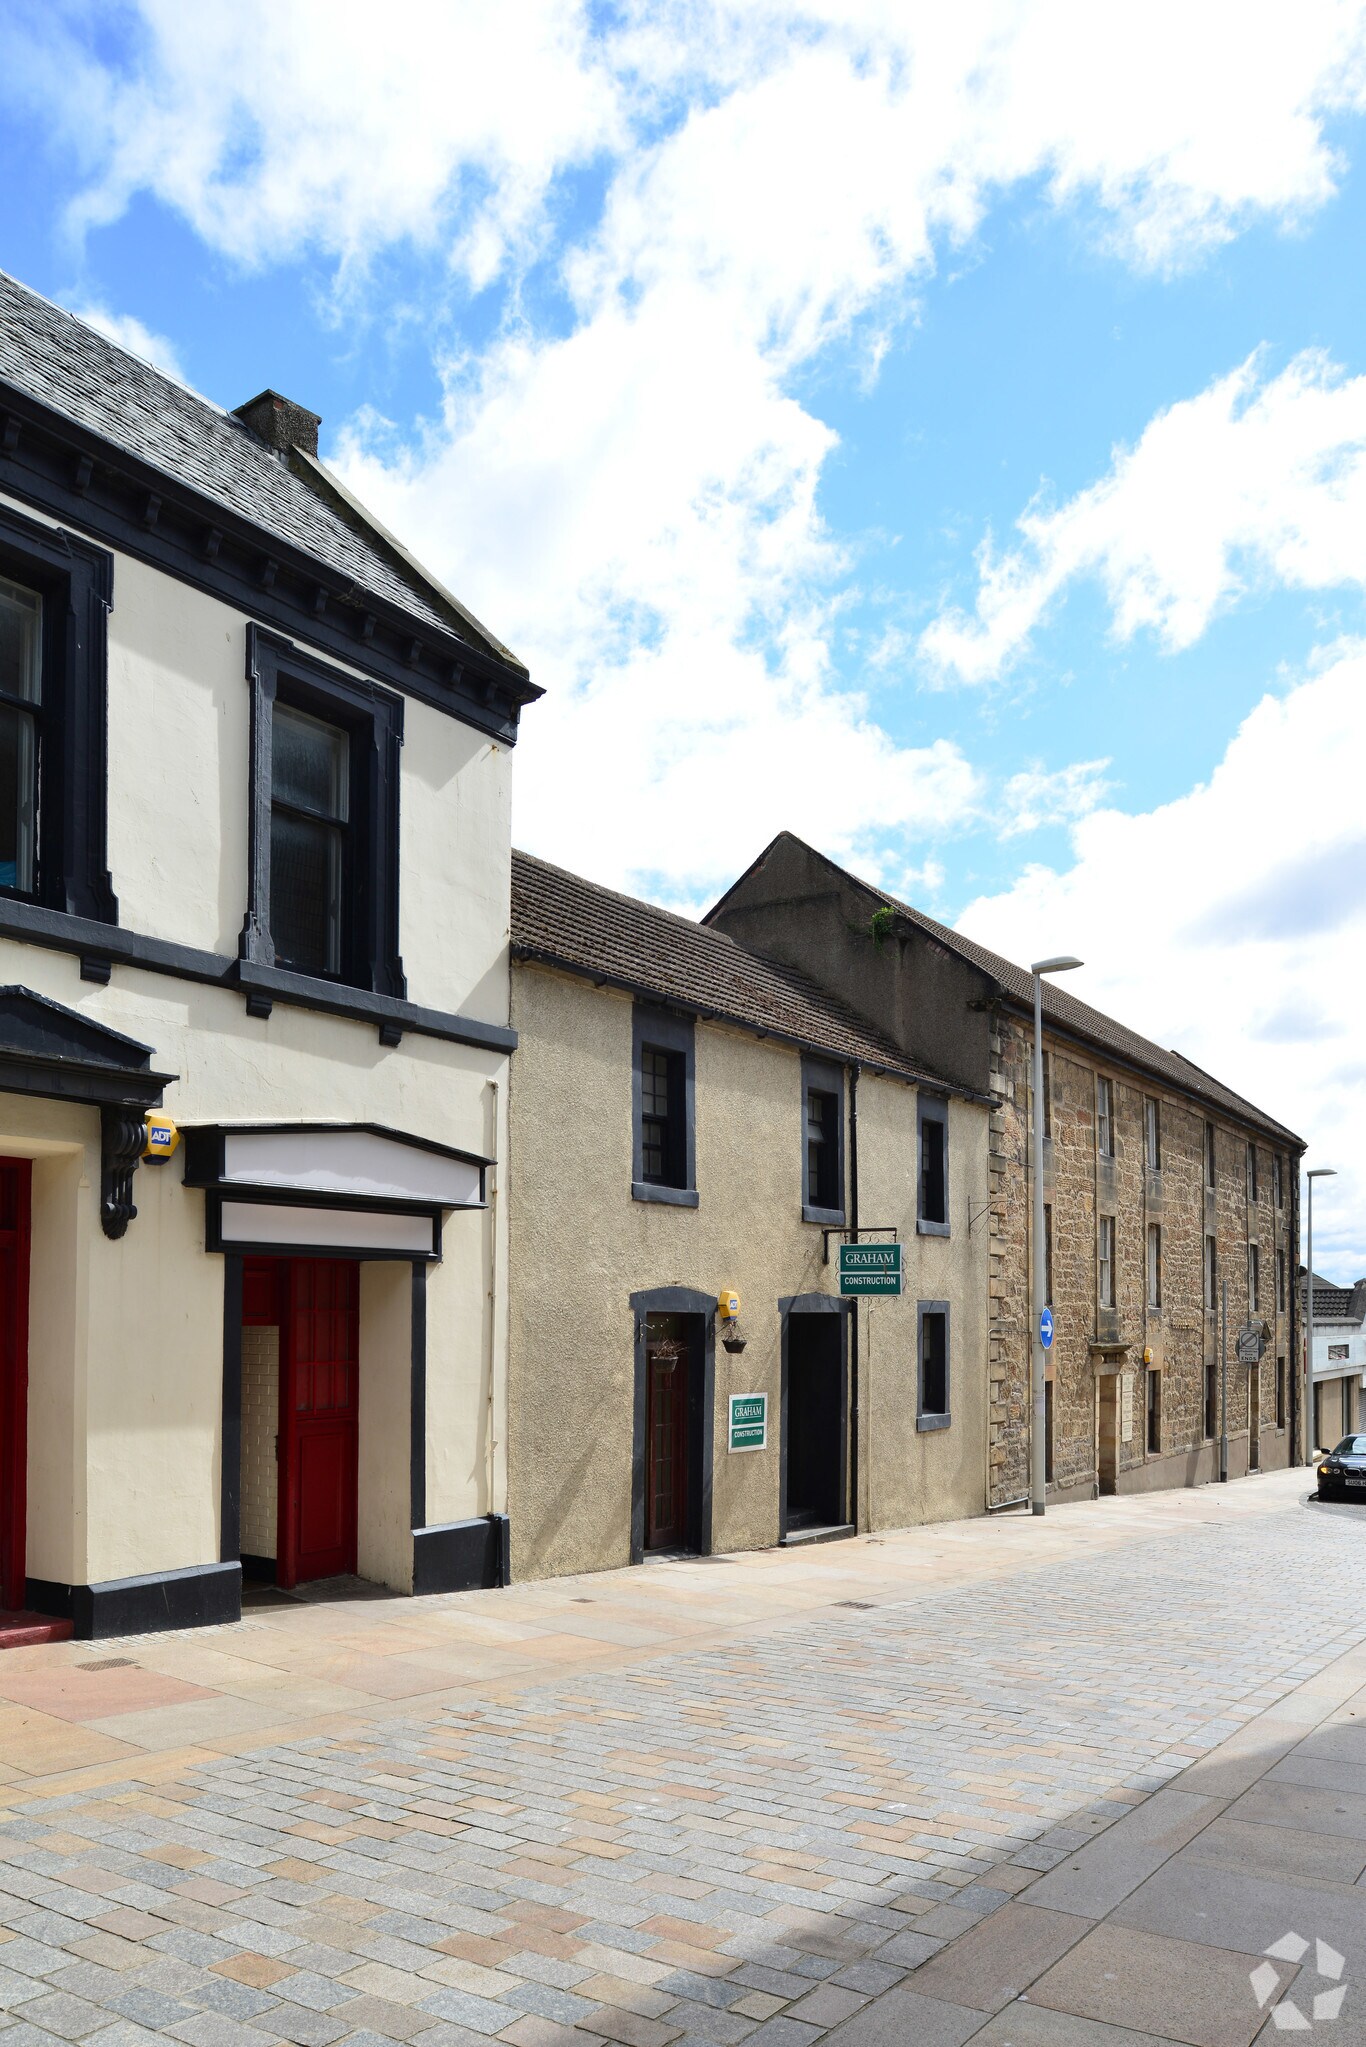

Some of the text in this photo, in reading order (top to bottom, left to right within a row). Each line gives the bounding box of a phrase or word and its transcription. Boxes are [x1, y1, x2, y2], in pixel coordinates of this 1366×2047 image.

[152, 1131, 170, 1142] ADT
[845, 1253, 895, 1264] GRAHAM
[844, 1276, 896, 1285] CONSTRUCTION
[734, 1406, 762, 1417] GRAHAM
[734, 1429, 763, 1438] CONSTRUCTION
